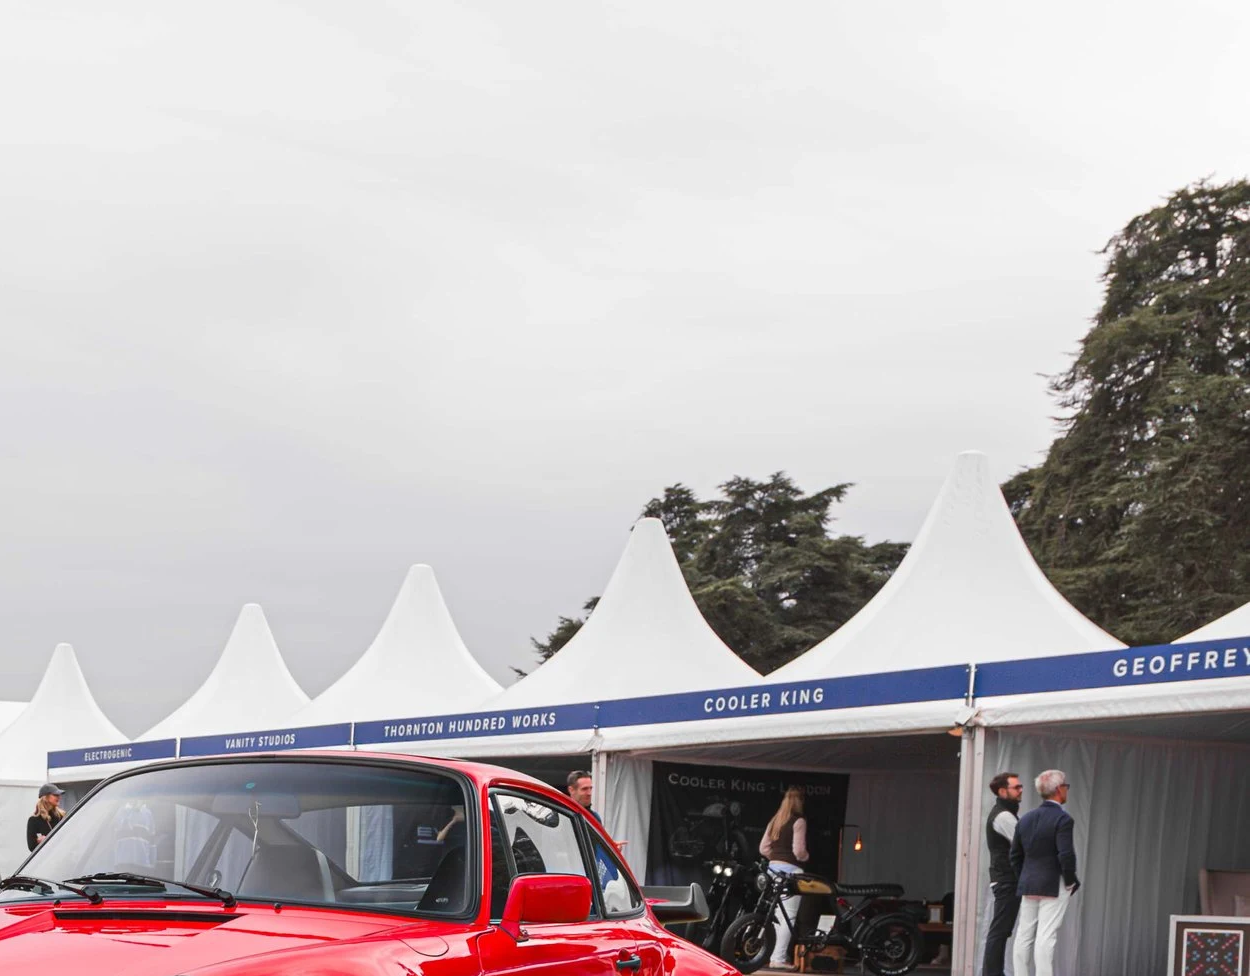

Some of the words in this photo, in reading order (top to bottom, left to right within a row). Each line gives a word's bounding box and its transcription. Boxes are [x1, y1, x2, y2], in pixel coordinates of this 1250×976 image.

[704, 693, 771, 712] COOLER
[780, 687, 824, 706] KING
[384, 721, 443, 737] THORNTON
[449, 716, 506, 733] HUNDRED
[512, 712, 556, 729] WORKS
[225, 737, 256, 749] VANITY
[258, 733, 296, 747] STUDIOS
[84, 748, 132, 761] ELECTROGENIC
